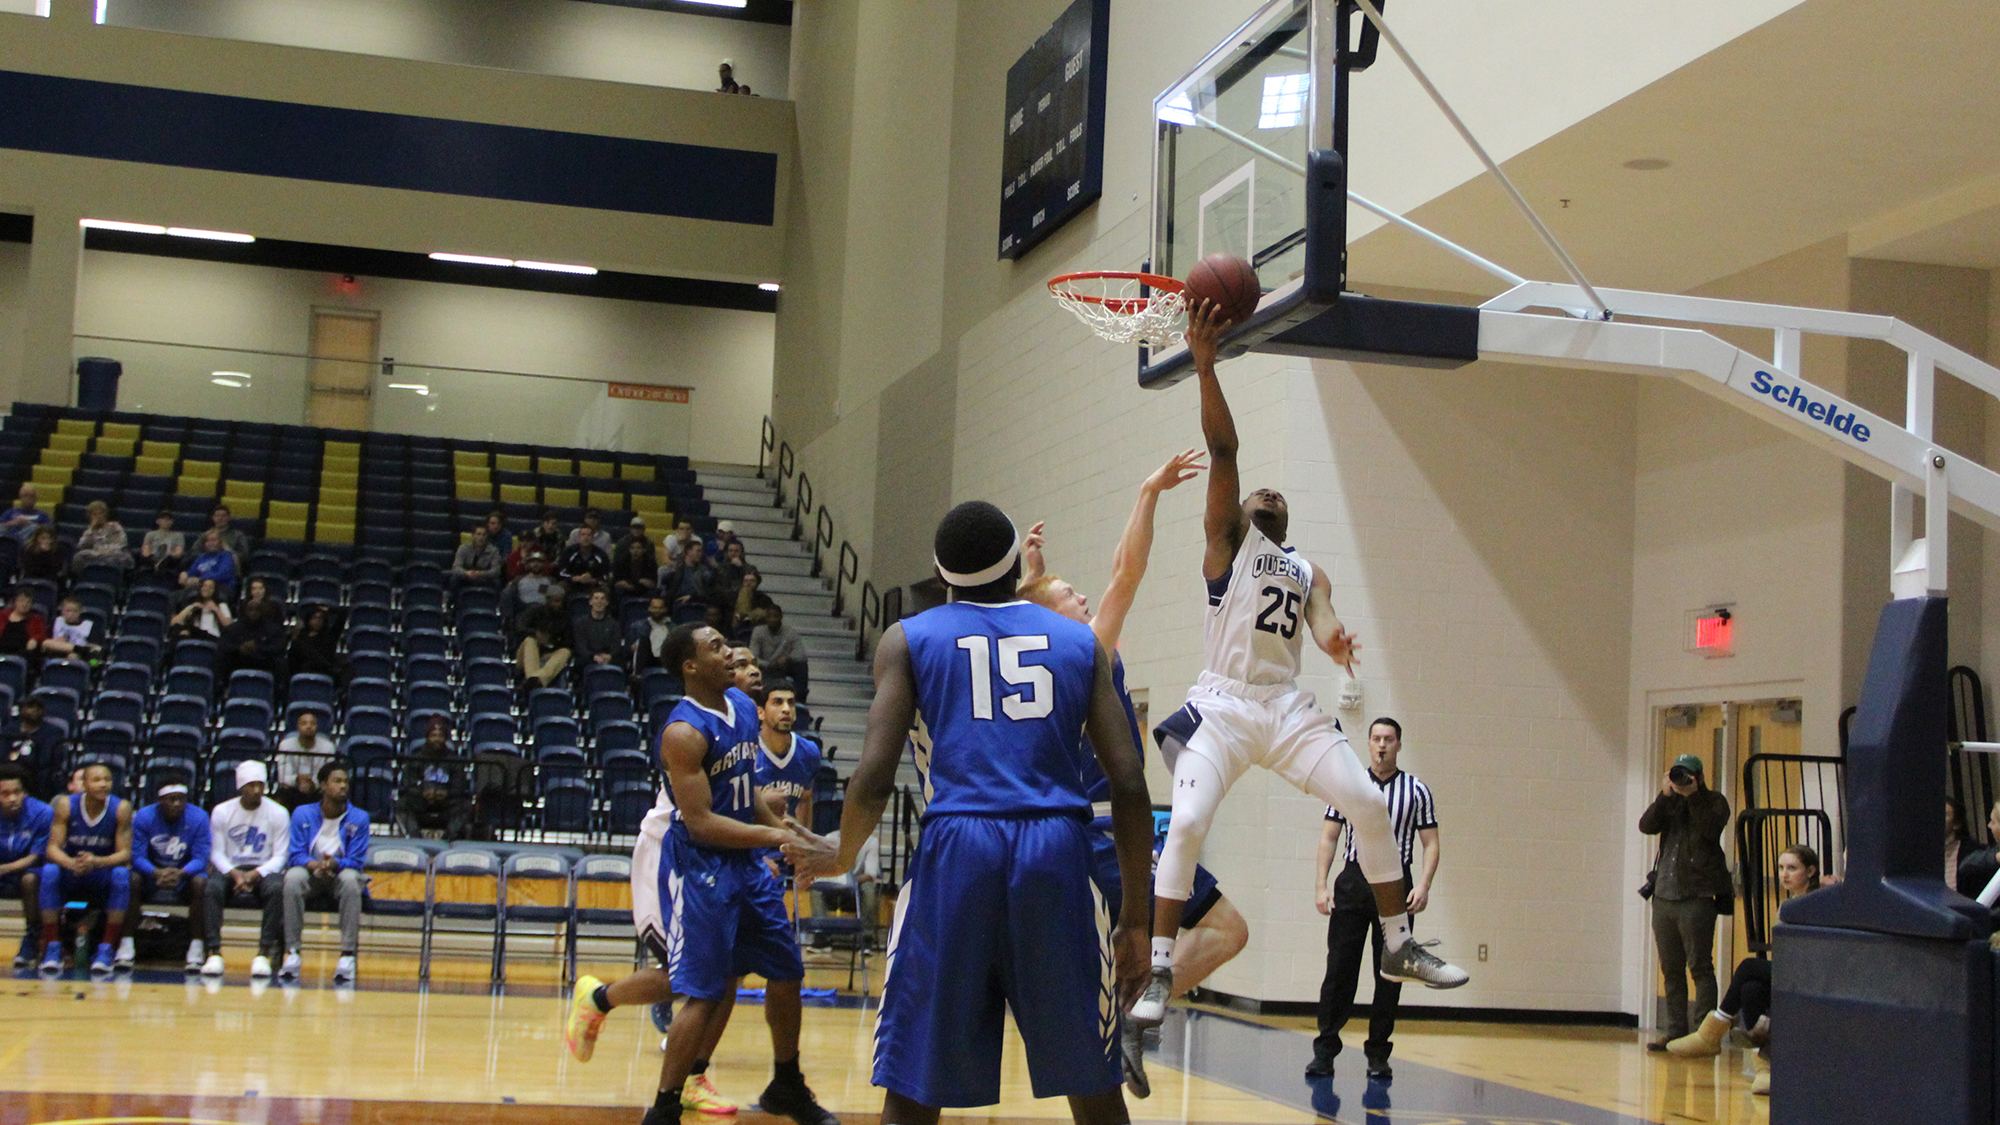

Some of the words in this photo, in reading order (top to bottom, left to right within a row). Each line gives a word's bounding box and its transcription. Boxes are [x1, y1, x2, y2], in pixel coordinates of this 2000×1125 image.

[1065, 49, 1083, 82] GUEST
[1750, 370, 1871, 443] Schelde
[1255, 585, 1301, 640] 25
[956, 634, 1054, 721] 15
[729, 772, 751, 812] 11
